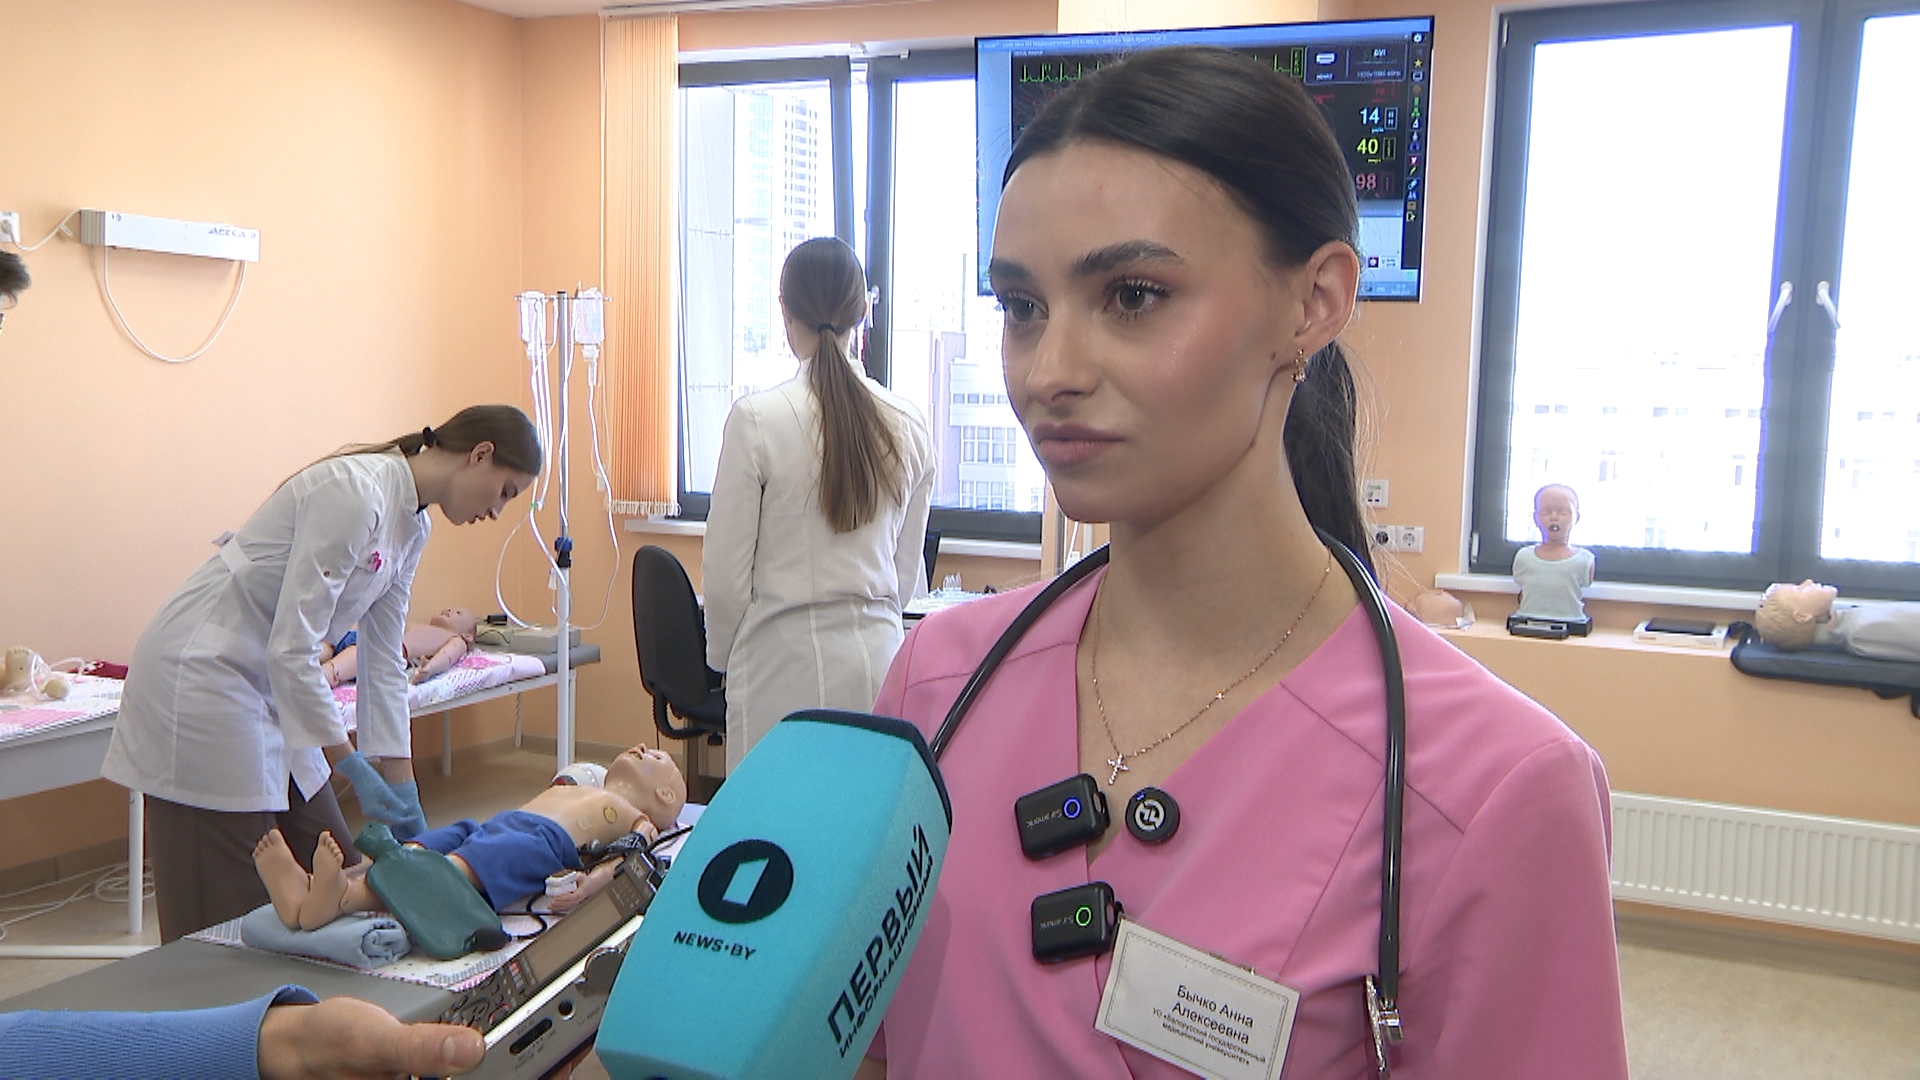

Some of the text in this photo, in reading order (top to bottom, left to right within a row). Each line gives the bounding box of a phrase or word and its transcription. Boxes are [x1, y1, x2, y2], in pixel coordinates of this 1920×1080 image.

[1360, 107, 1380, 125] 14
[1356, 138, 1379, 155] 40
[1355, 173, 1377, 190] 98
[827, 823, 930, 1044] ПЕРВЫЙ
[1176, 984, 1254, 1029] Бычко Анна
[1171, 1001, 1250, 1045] Алексеевна
